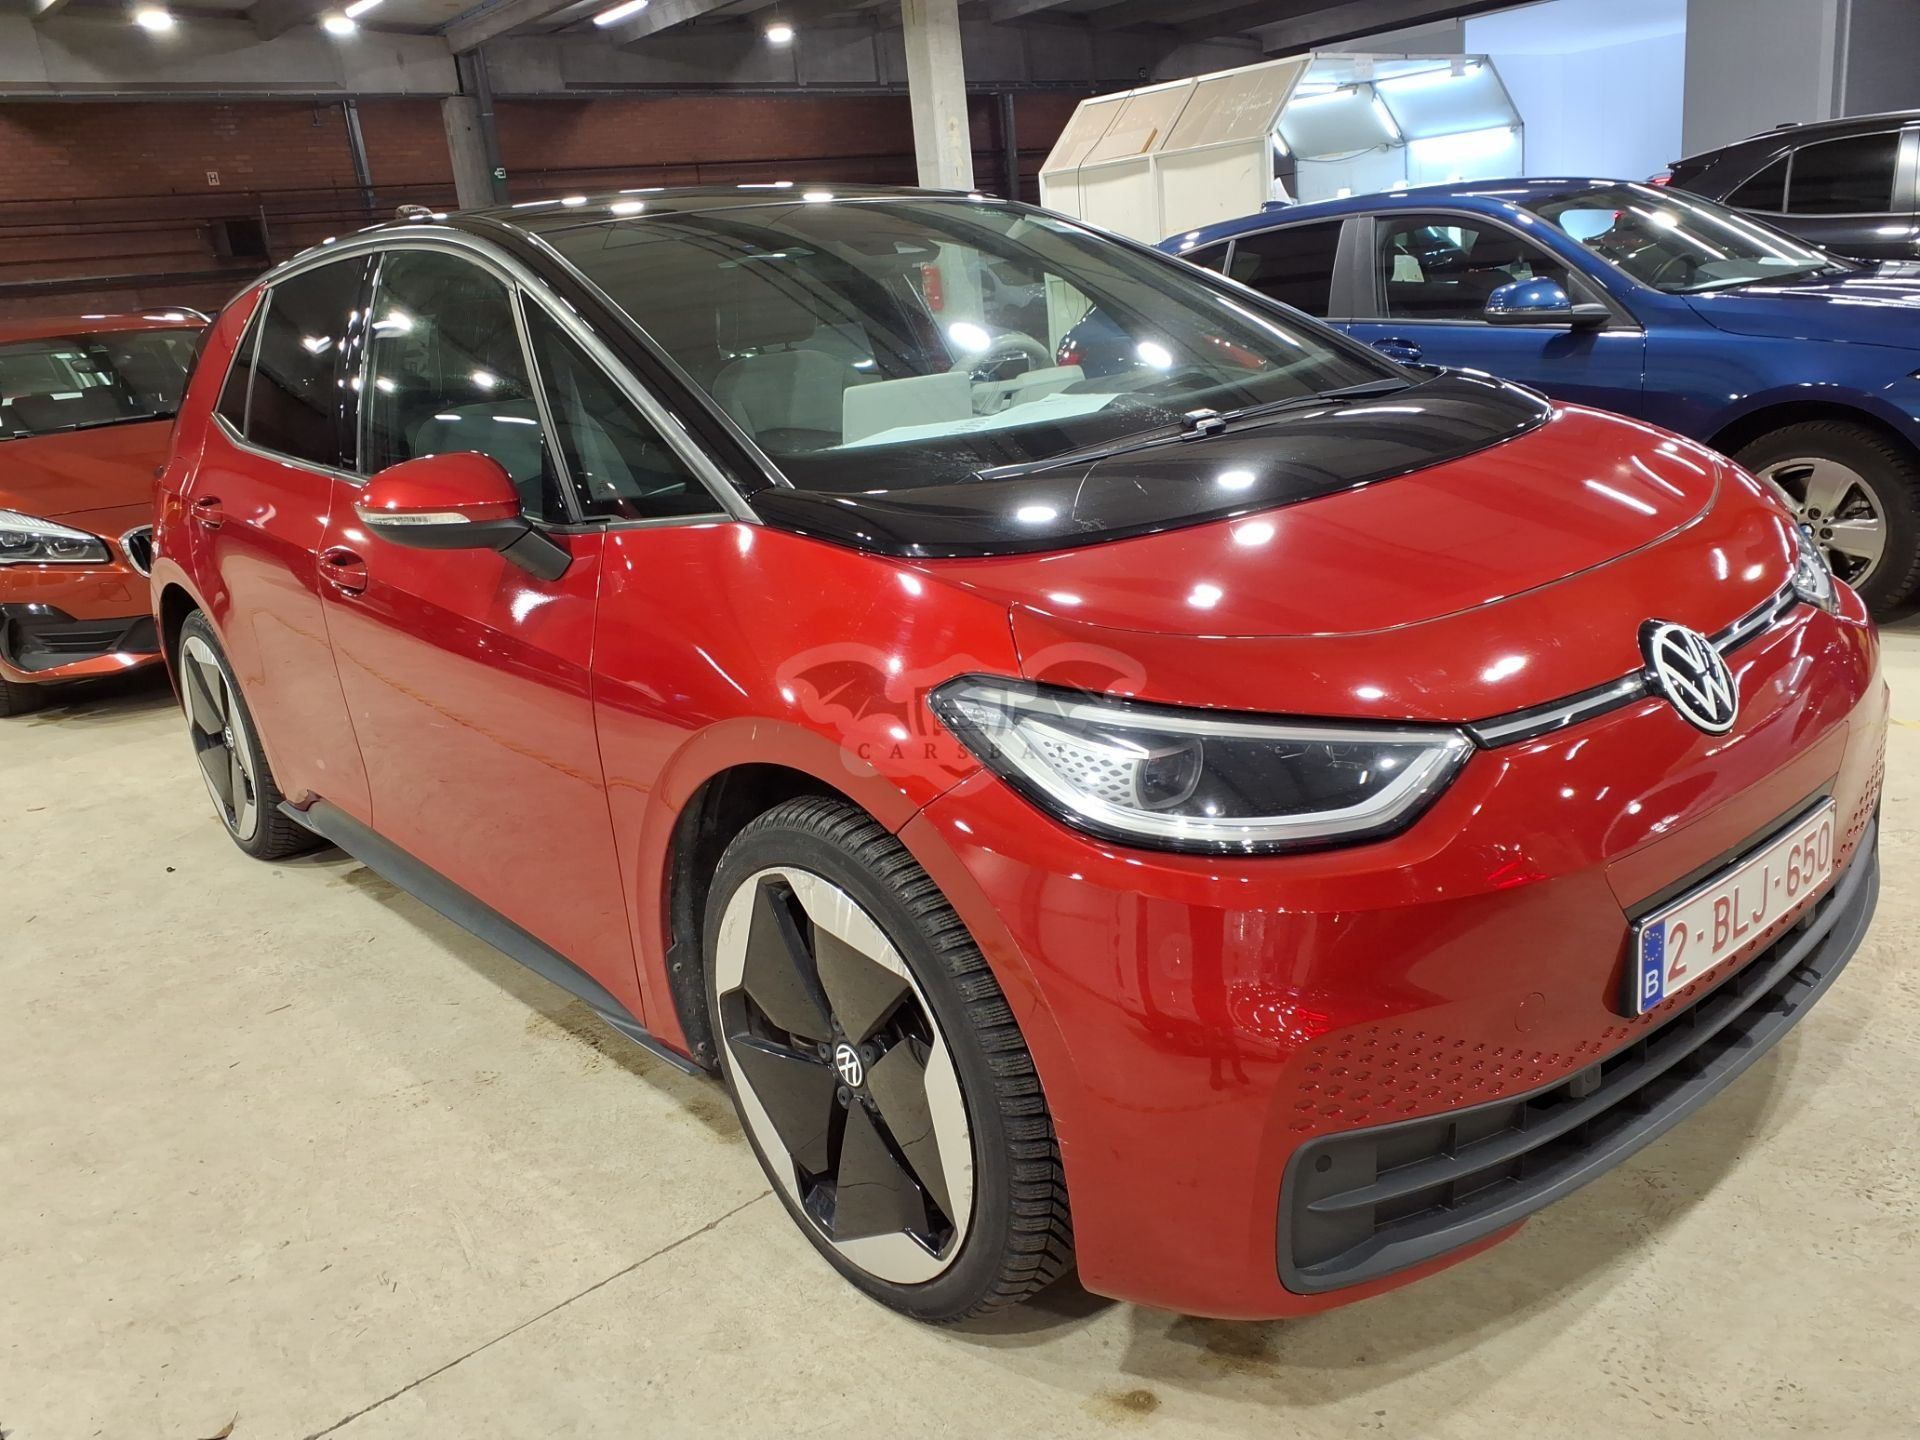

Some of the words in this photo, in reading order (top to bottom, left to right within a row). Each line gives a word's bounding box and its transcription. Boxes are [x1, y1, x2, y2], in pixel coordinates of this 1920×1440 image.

[1654, 625, 1737, 731] VW
[1667, 821, 1830, 983] 2-BLJ-650
[1645, 969, 1659, 999] B
